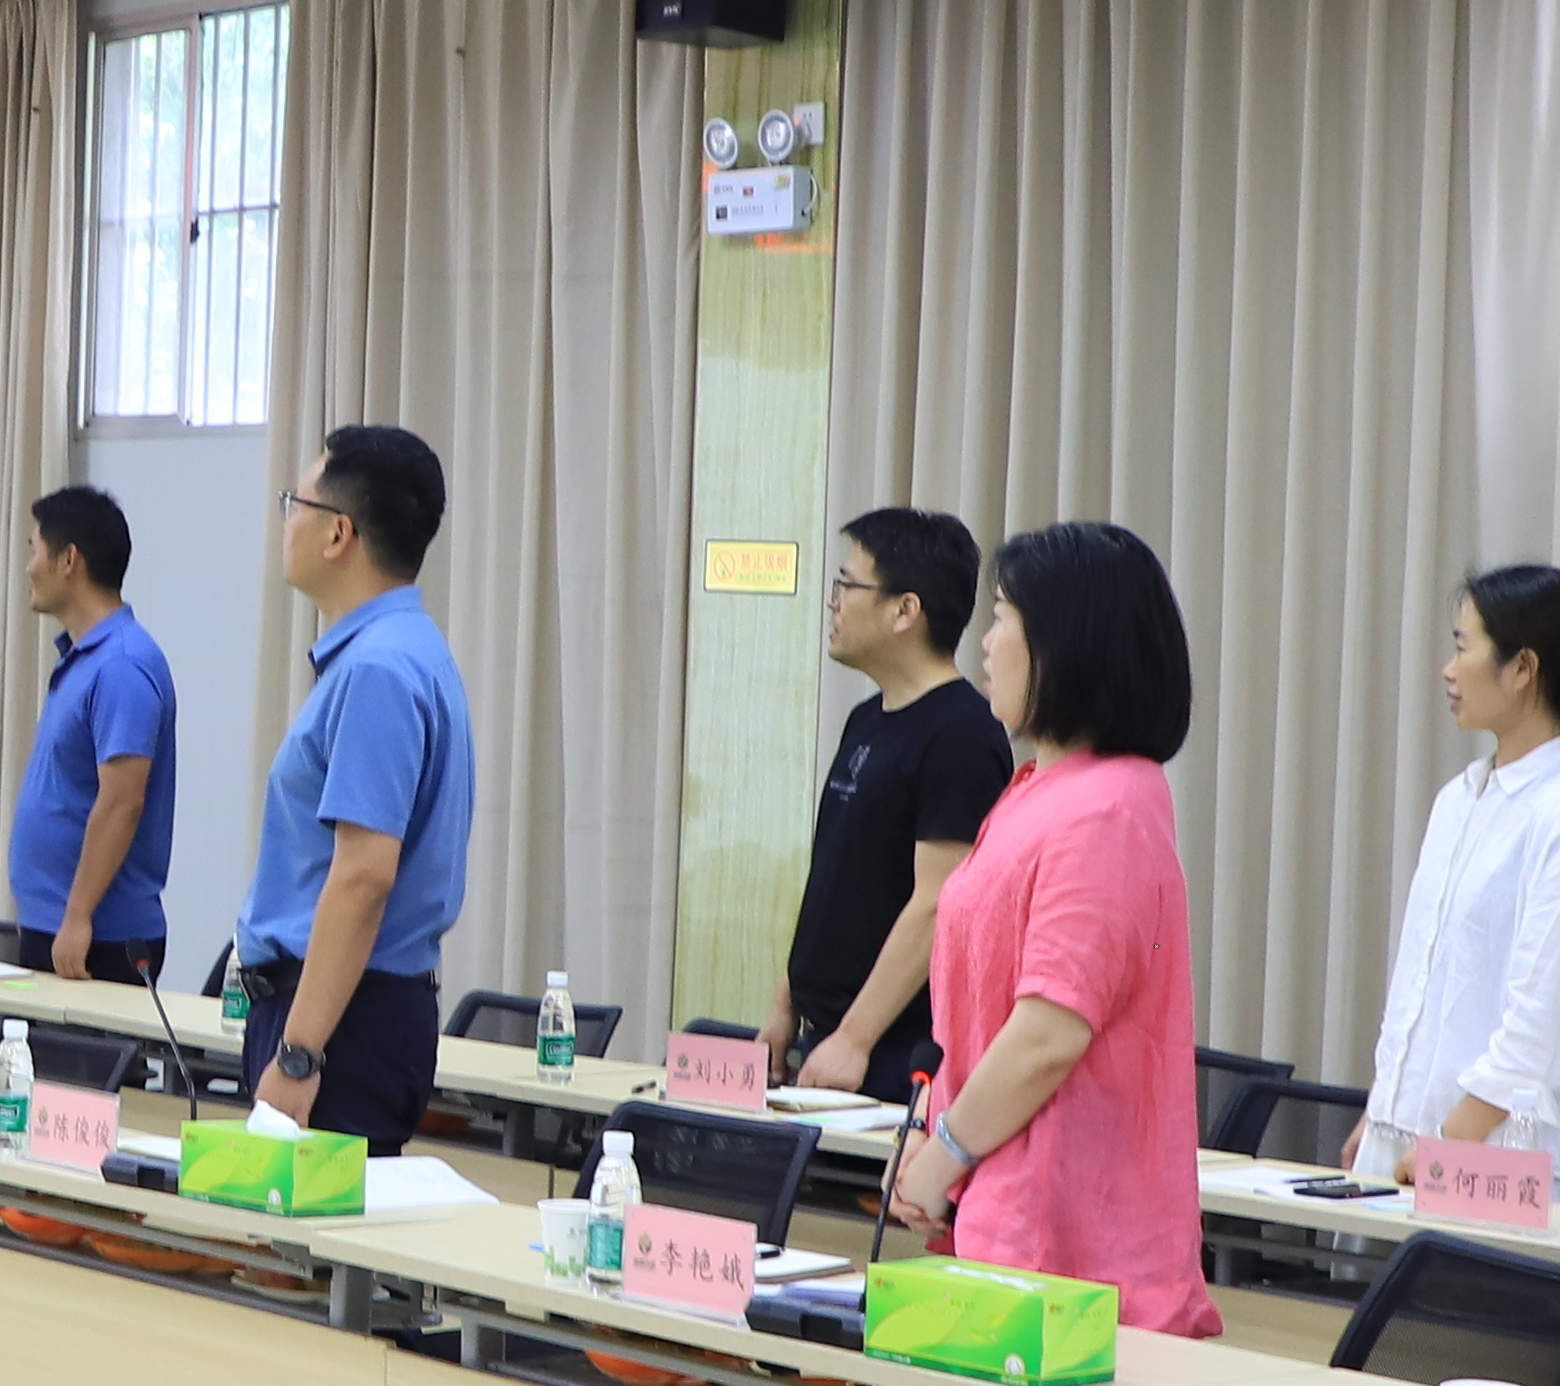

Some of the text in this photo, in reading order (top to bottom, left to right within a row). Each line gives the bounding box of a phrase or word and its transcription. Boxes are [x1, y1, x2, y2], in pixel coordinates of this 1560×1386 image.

[695, 1058, 755, 1091] 刘小勇
[1454, 1167, 1541, 1209] 何丽霞
